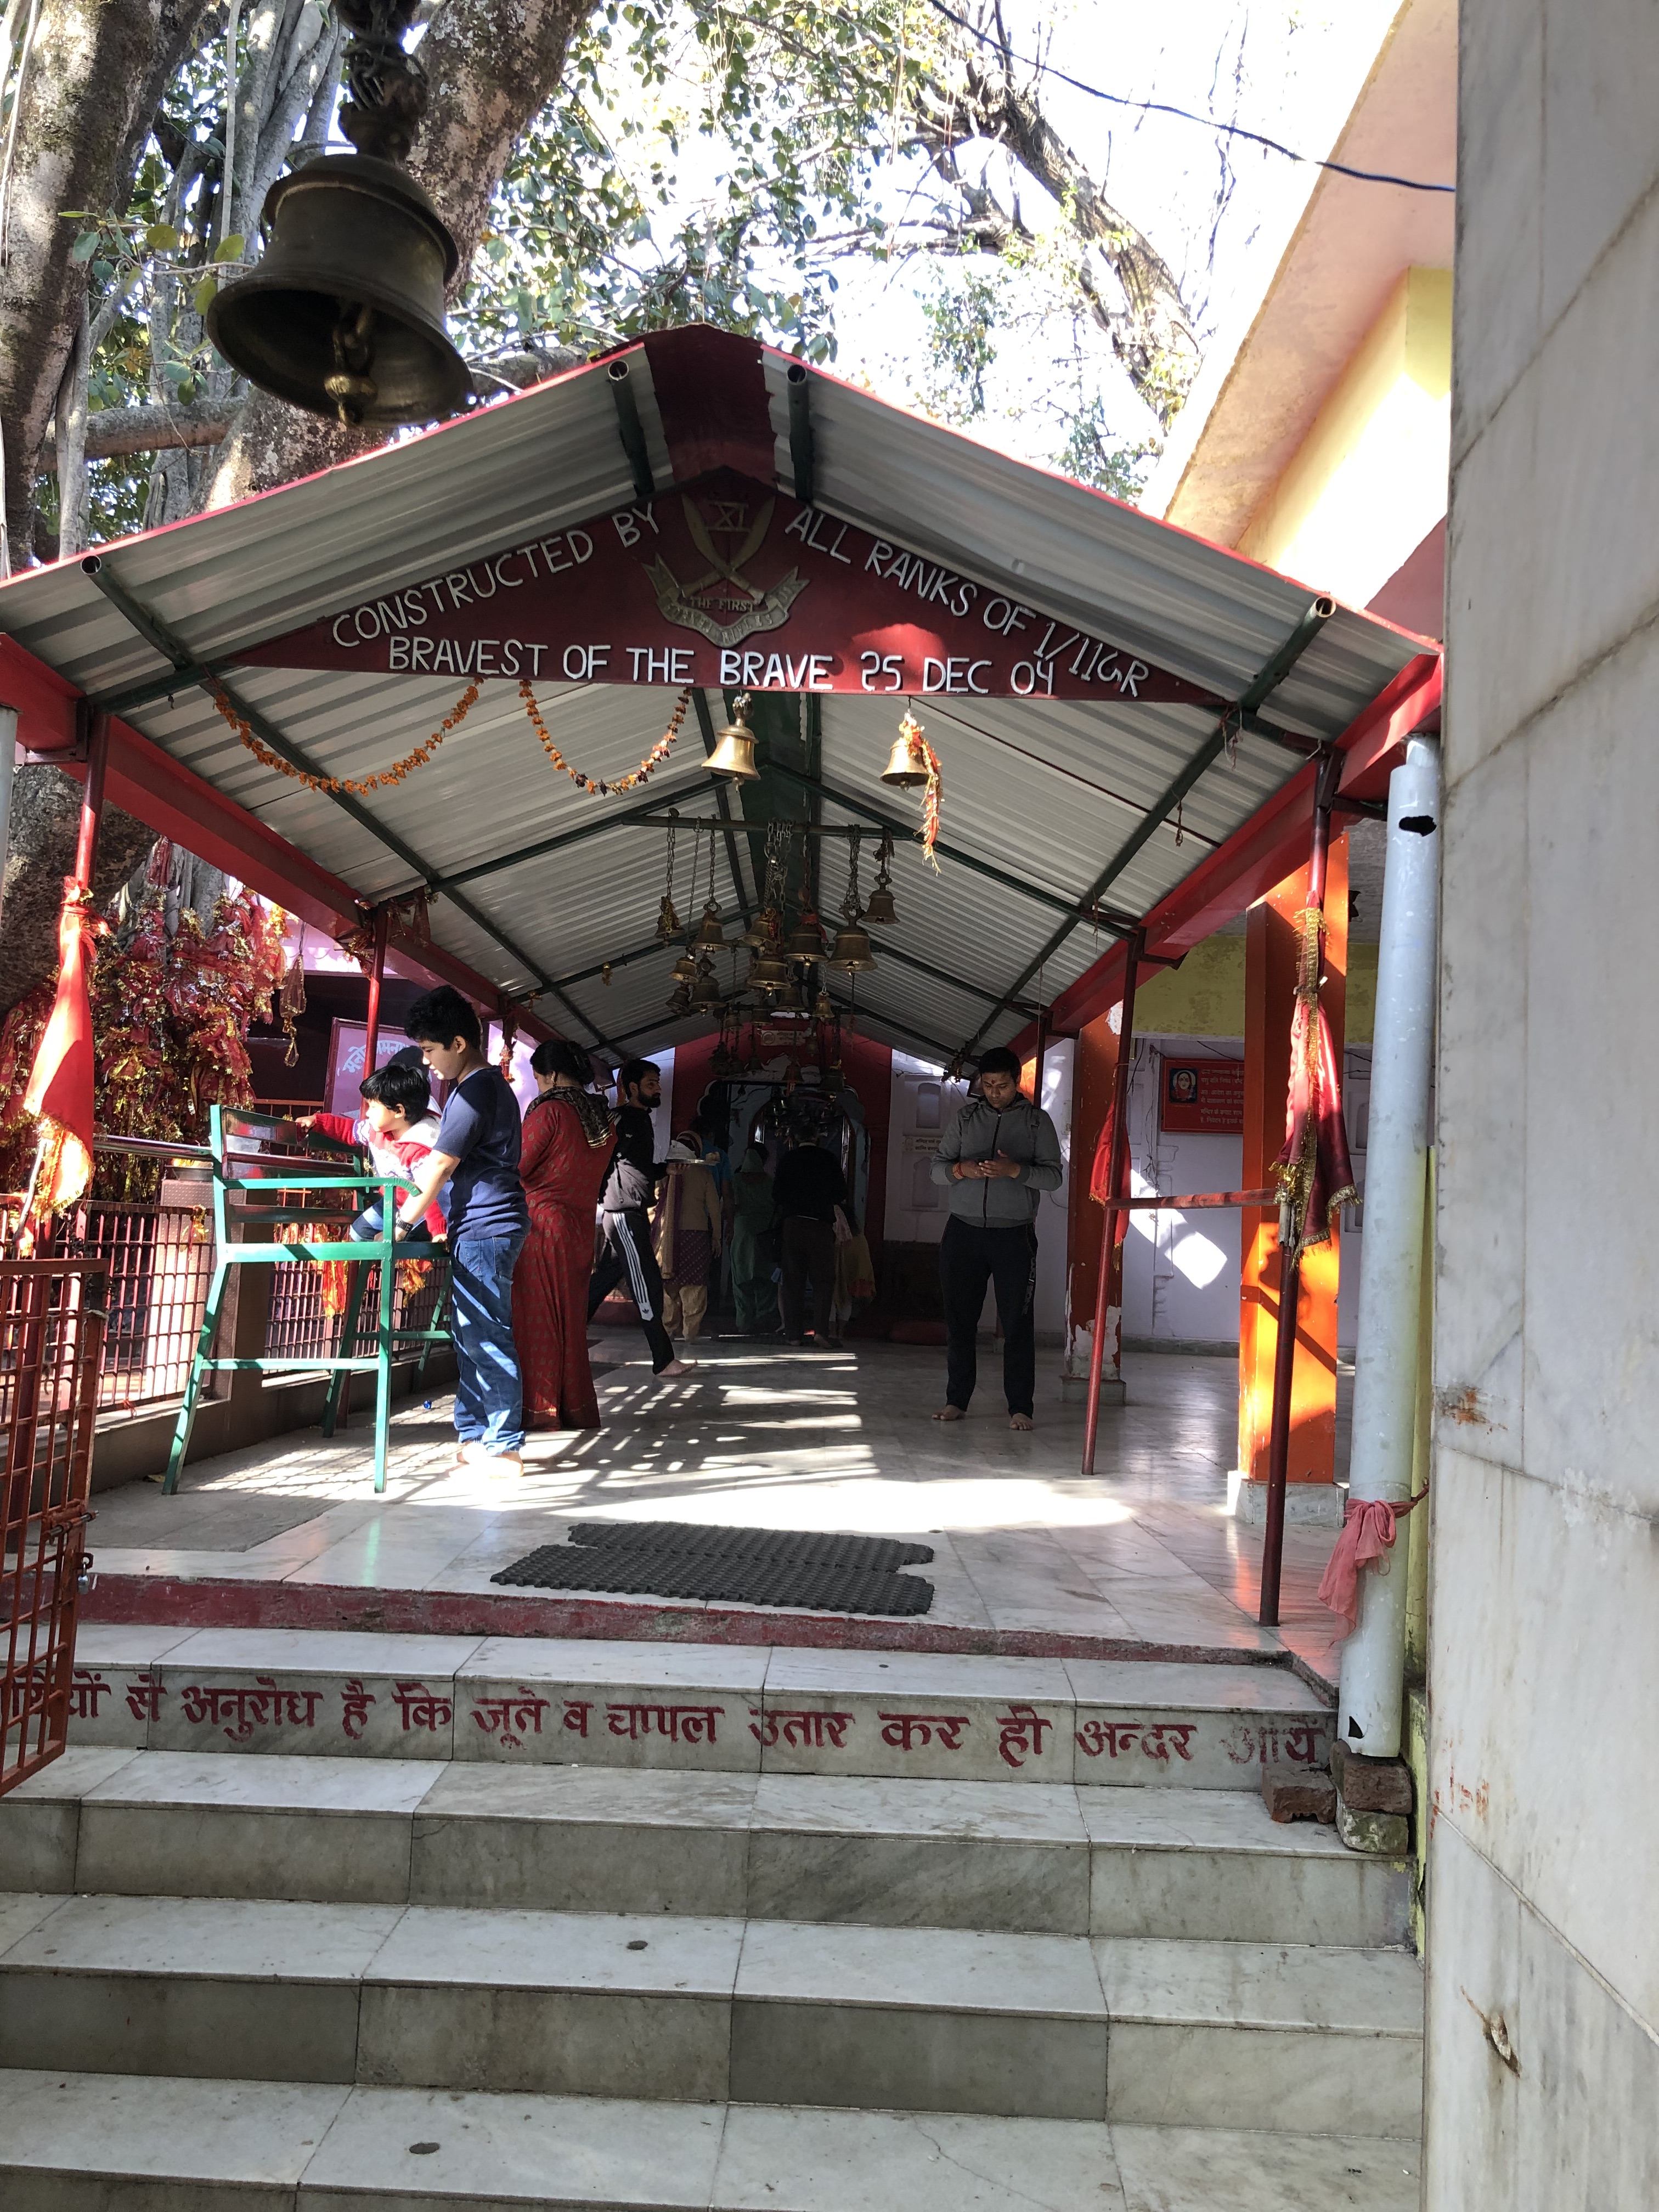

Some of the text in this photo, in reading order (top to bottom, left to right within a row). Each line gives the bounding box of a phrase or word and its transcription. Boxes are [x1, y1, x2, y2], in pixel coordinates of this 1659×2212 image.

[332, 502, 659, 647] CONSTRUCTED BY
[690, 596, 754, 613] THE FIRST
[785, 506, 851, 564] ALL
[864, 540, 978, 617] RANKS
[983, 597, 1037, 636] OF
[389, 636, 1054, 696] BRAVEST OF THE BRAVE 25 DEC 04
[125, 1672, 168, 1722] से
[181, 1677, 324, 1742] अनुरोध
[340, 1679, 376, 1739] है
[391, 1682, 453, 1731] कि
[471, 1686, 550, 1749] जूते
[605, 1702, 725, 1743] चप्पल
[748, 1708, 855, 1748] उतार
[878, 1711, 970, 1751] कर
[996, 1705, 1053, 1768] ही
[1075, 1720, 1197, 1762] अन्दर
